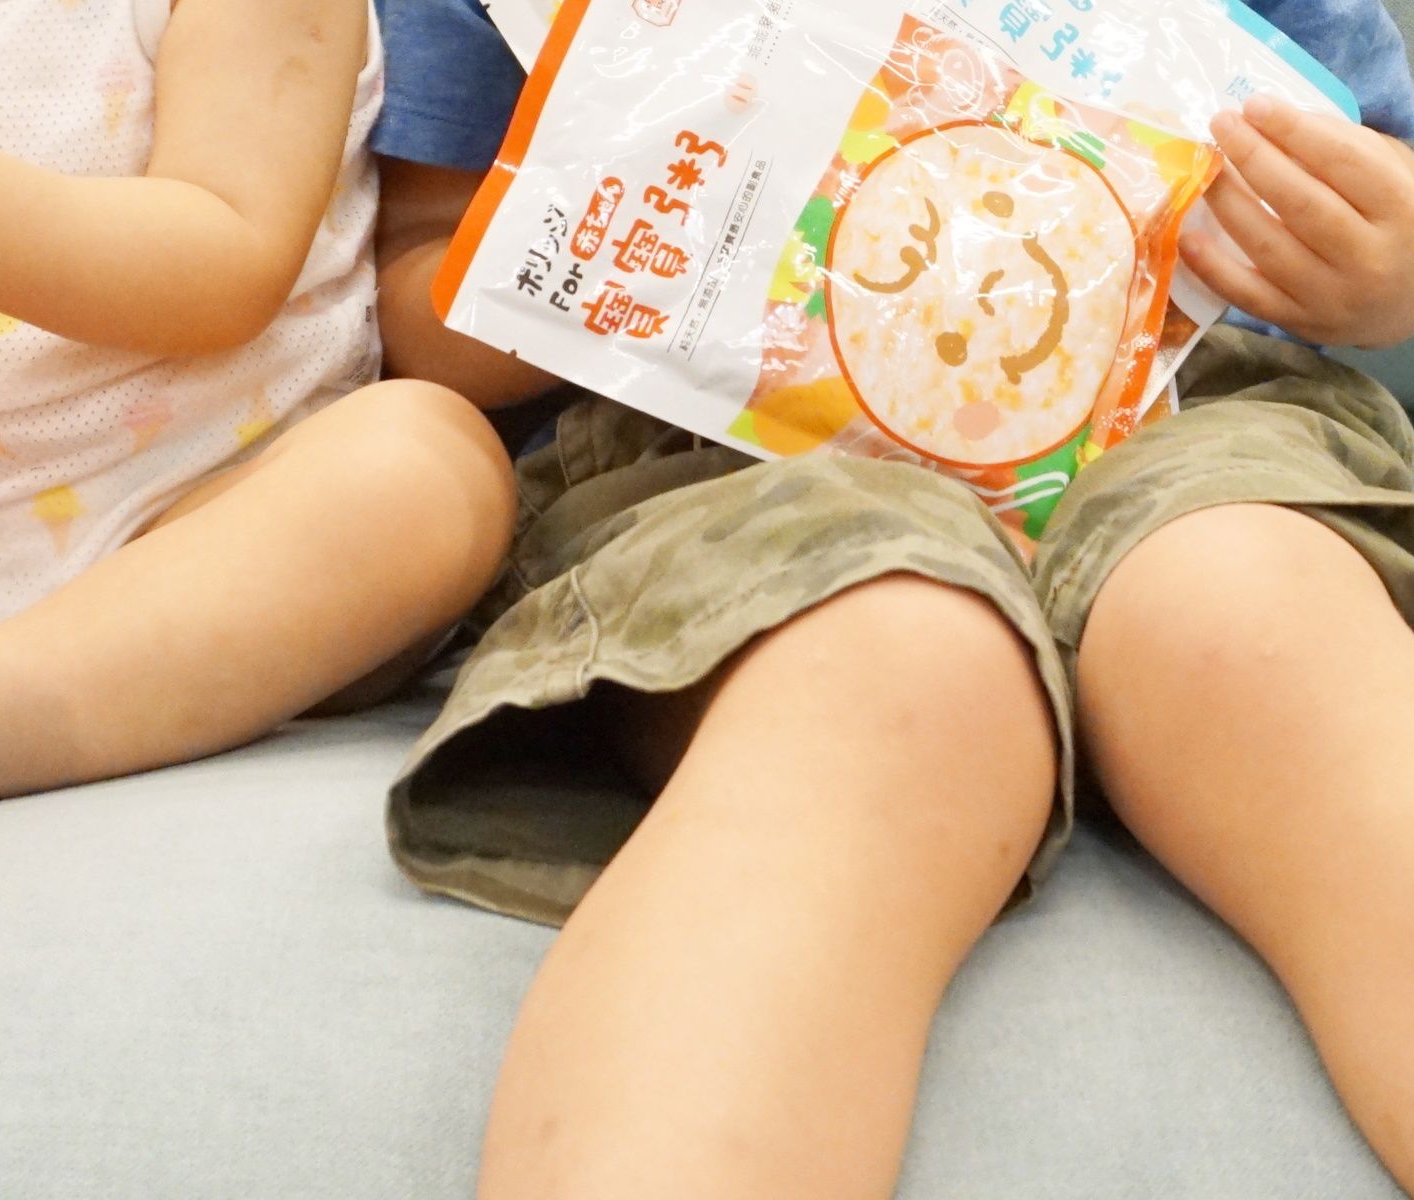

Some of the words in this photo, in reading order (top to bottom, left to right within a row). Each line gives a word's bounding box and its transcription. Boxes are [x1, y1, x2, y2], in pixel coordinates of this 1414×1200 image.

[548, 262, 584, 312] For
[580, 129, 728, 339] 寶寶粥
